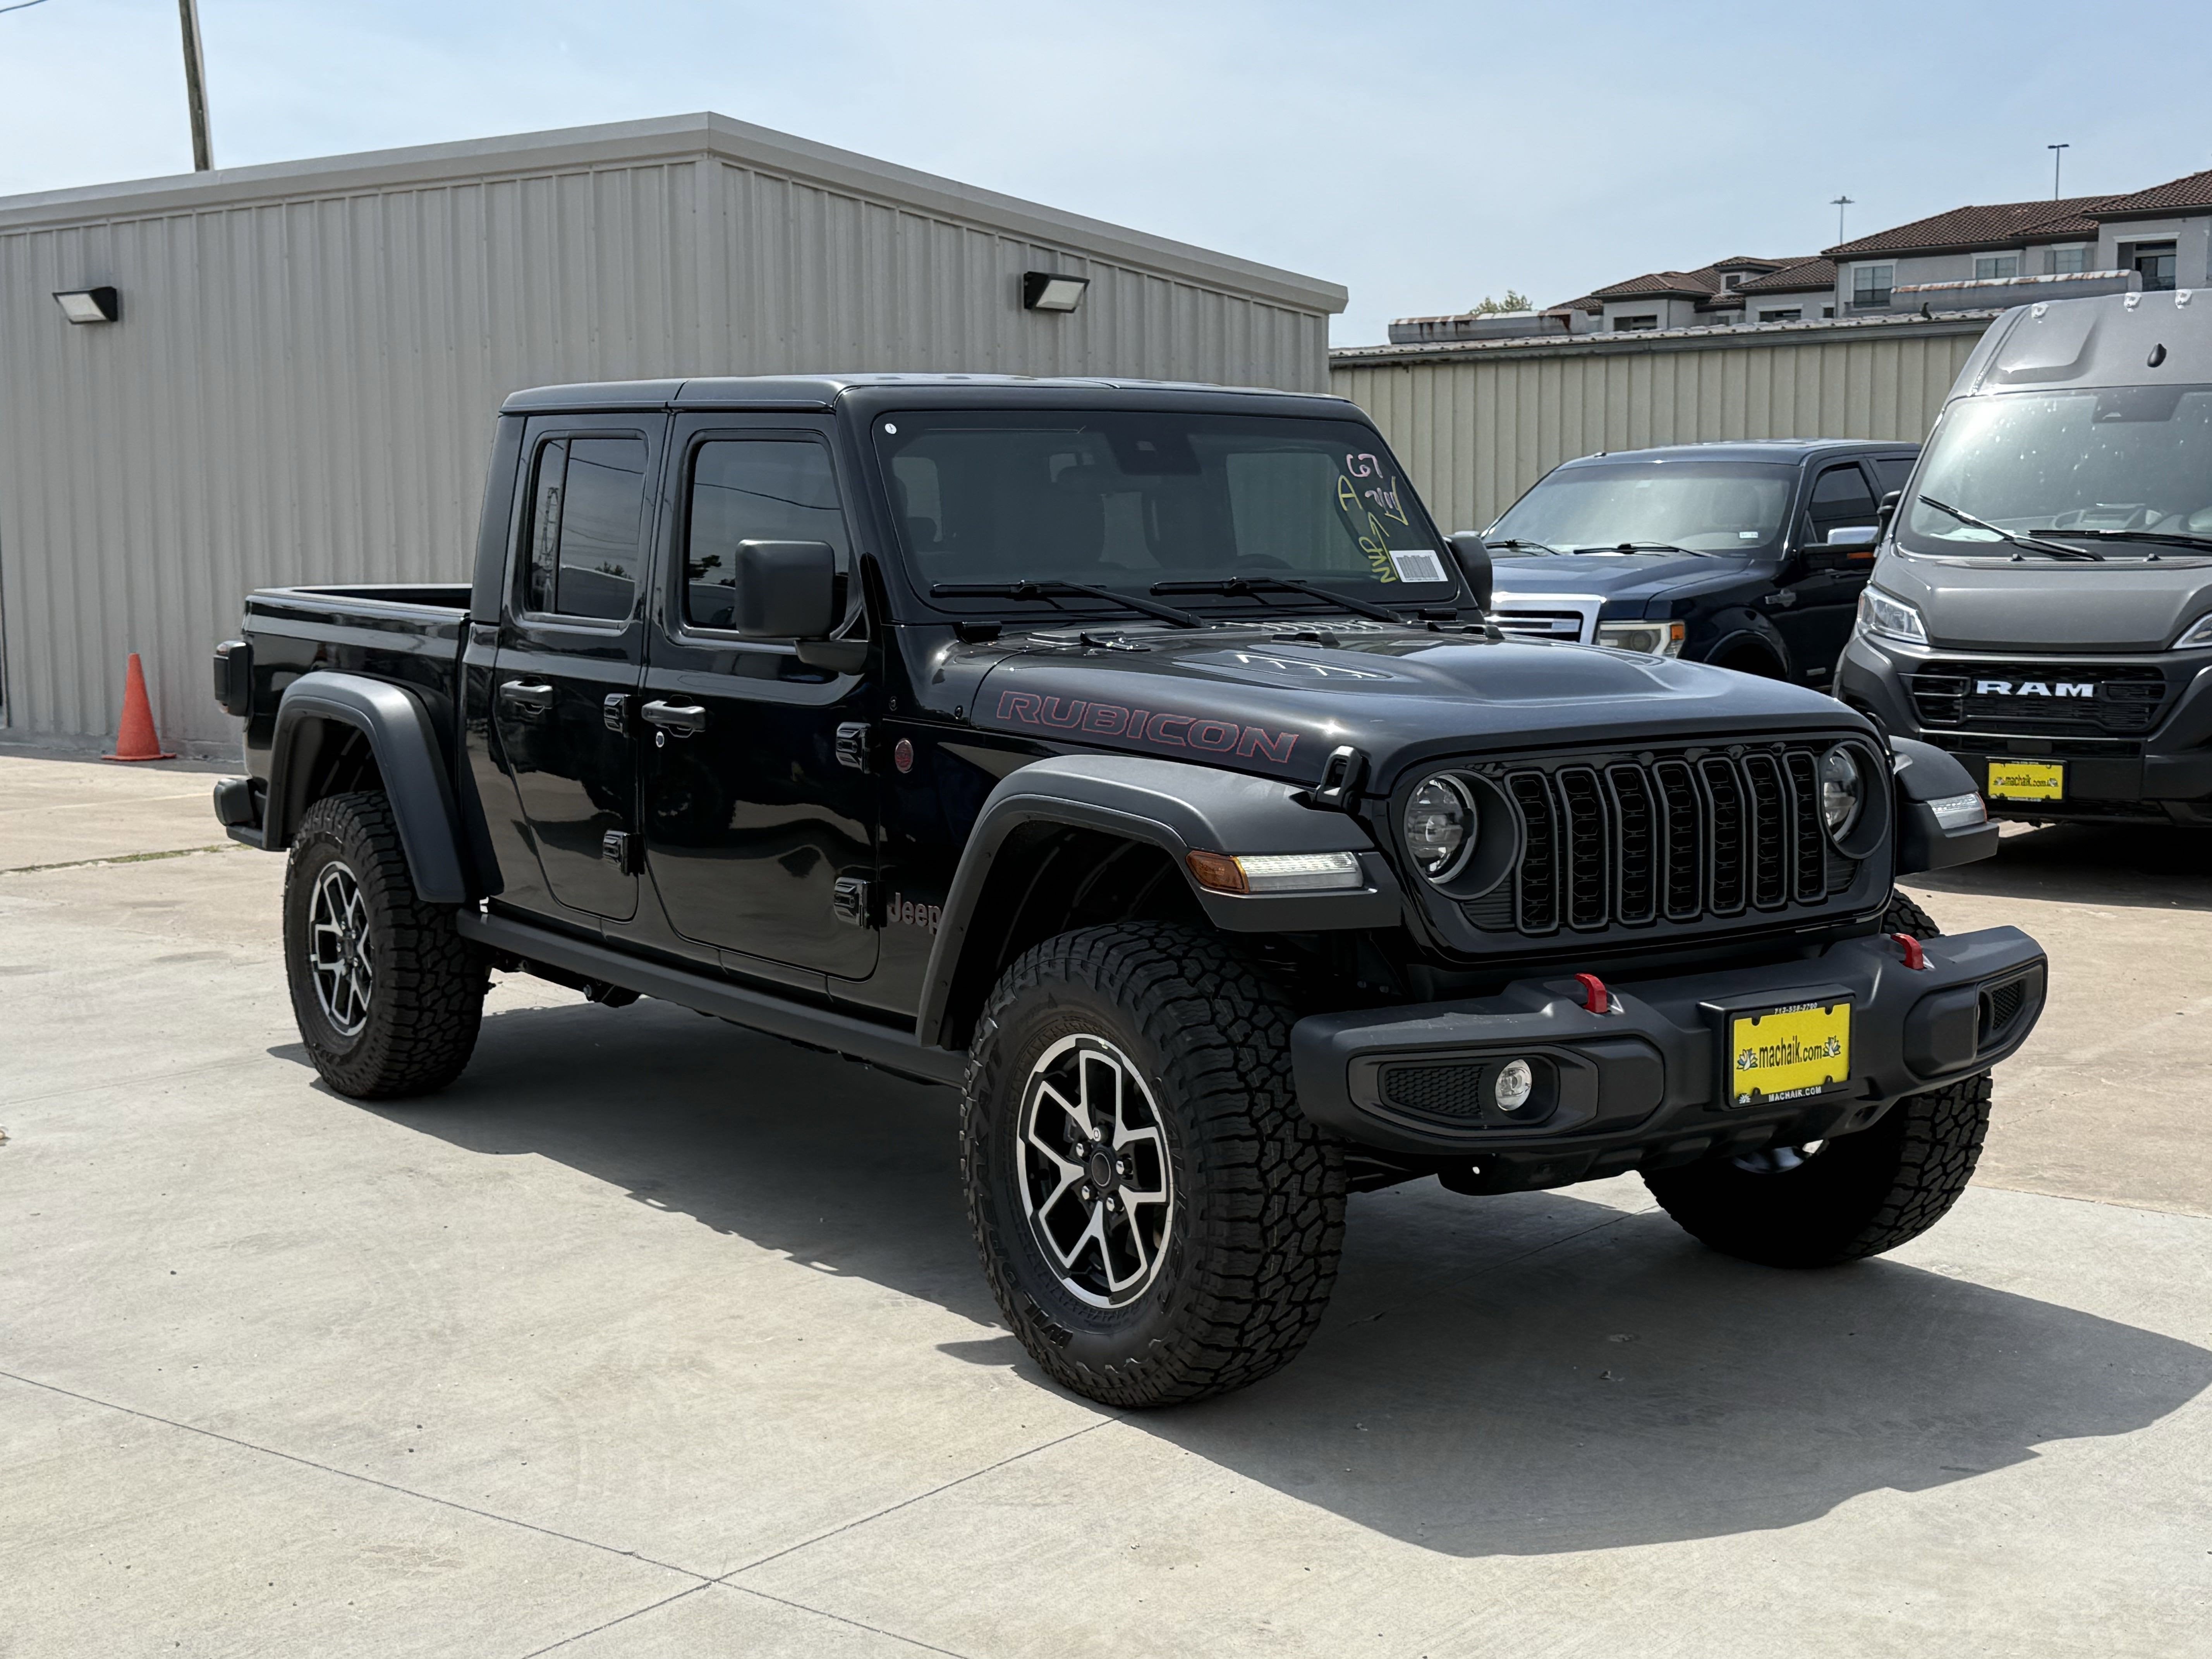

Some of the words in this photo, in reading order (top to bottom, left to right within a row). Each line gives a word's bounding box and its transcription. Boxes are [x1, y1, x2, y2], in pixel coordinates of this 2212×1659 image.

[1977, 680, 2094, 697] RAM
[996, 691, 1299, 764] RUBICON
[887, 892, 941, 936] Jeep
[1759, 1035, 1822, 1068] machaik.com
[1768, 1086, 1822, 1103] MACHAIK.COM
